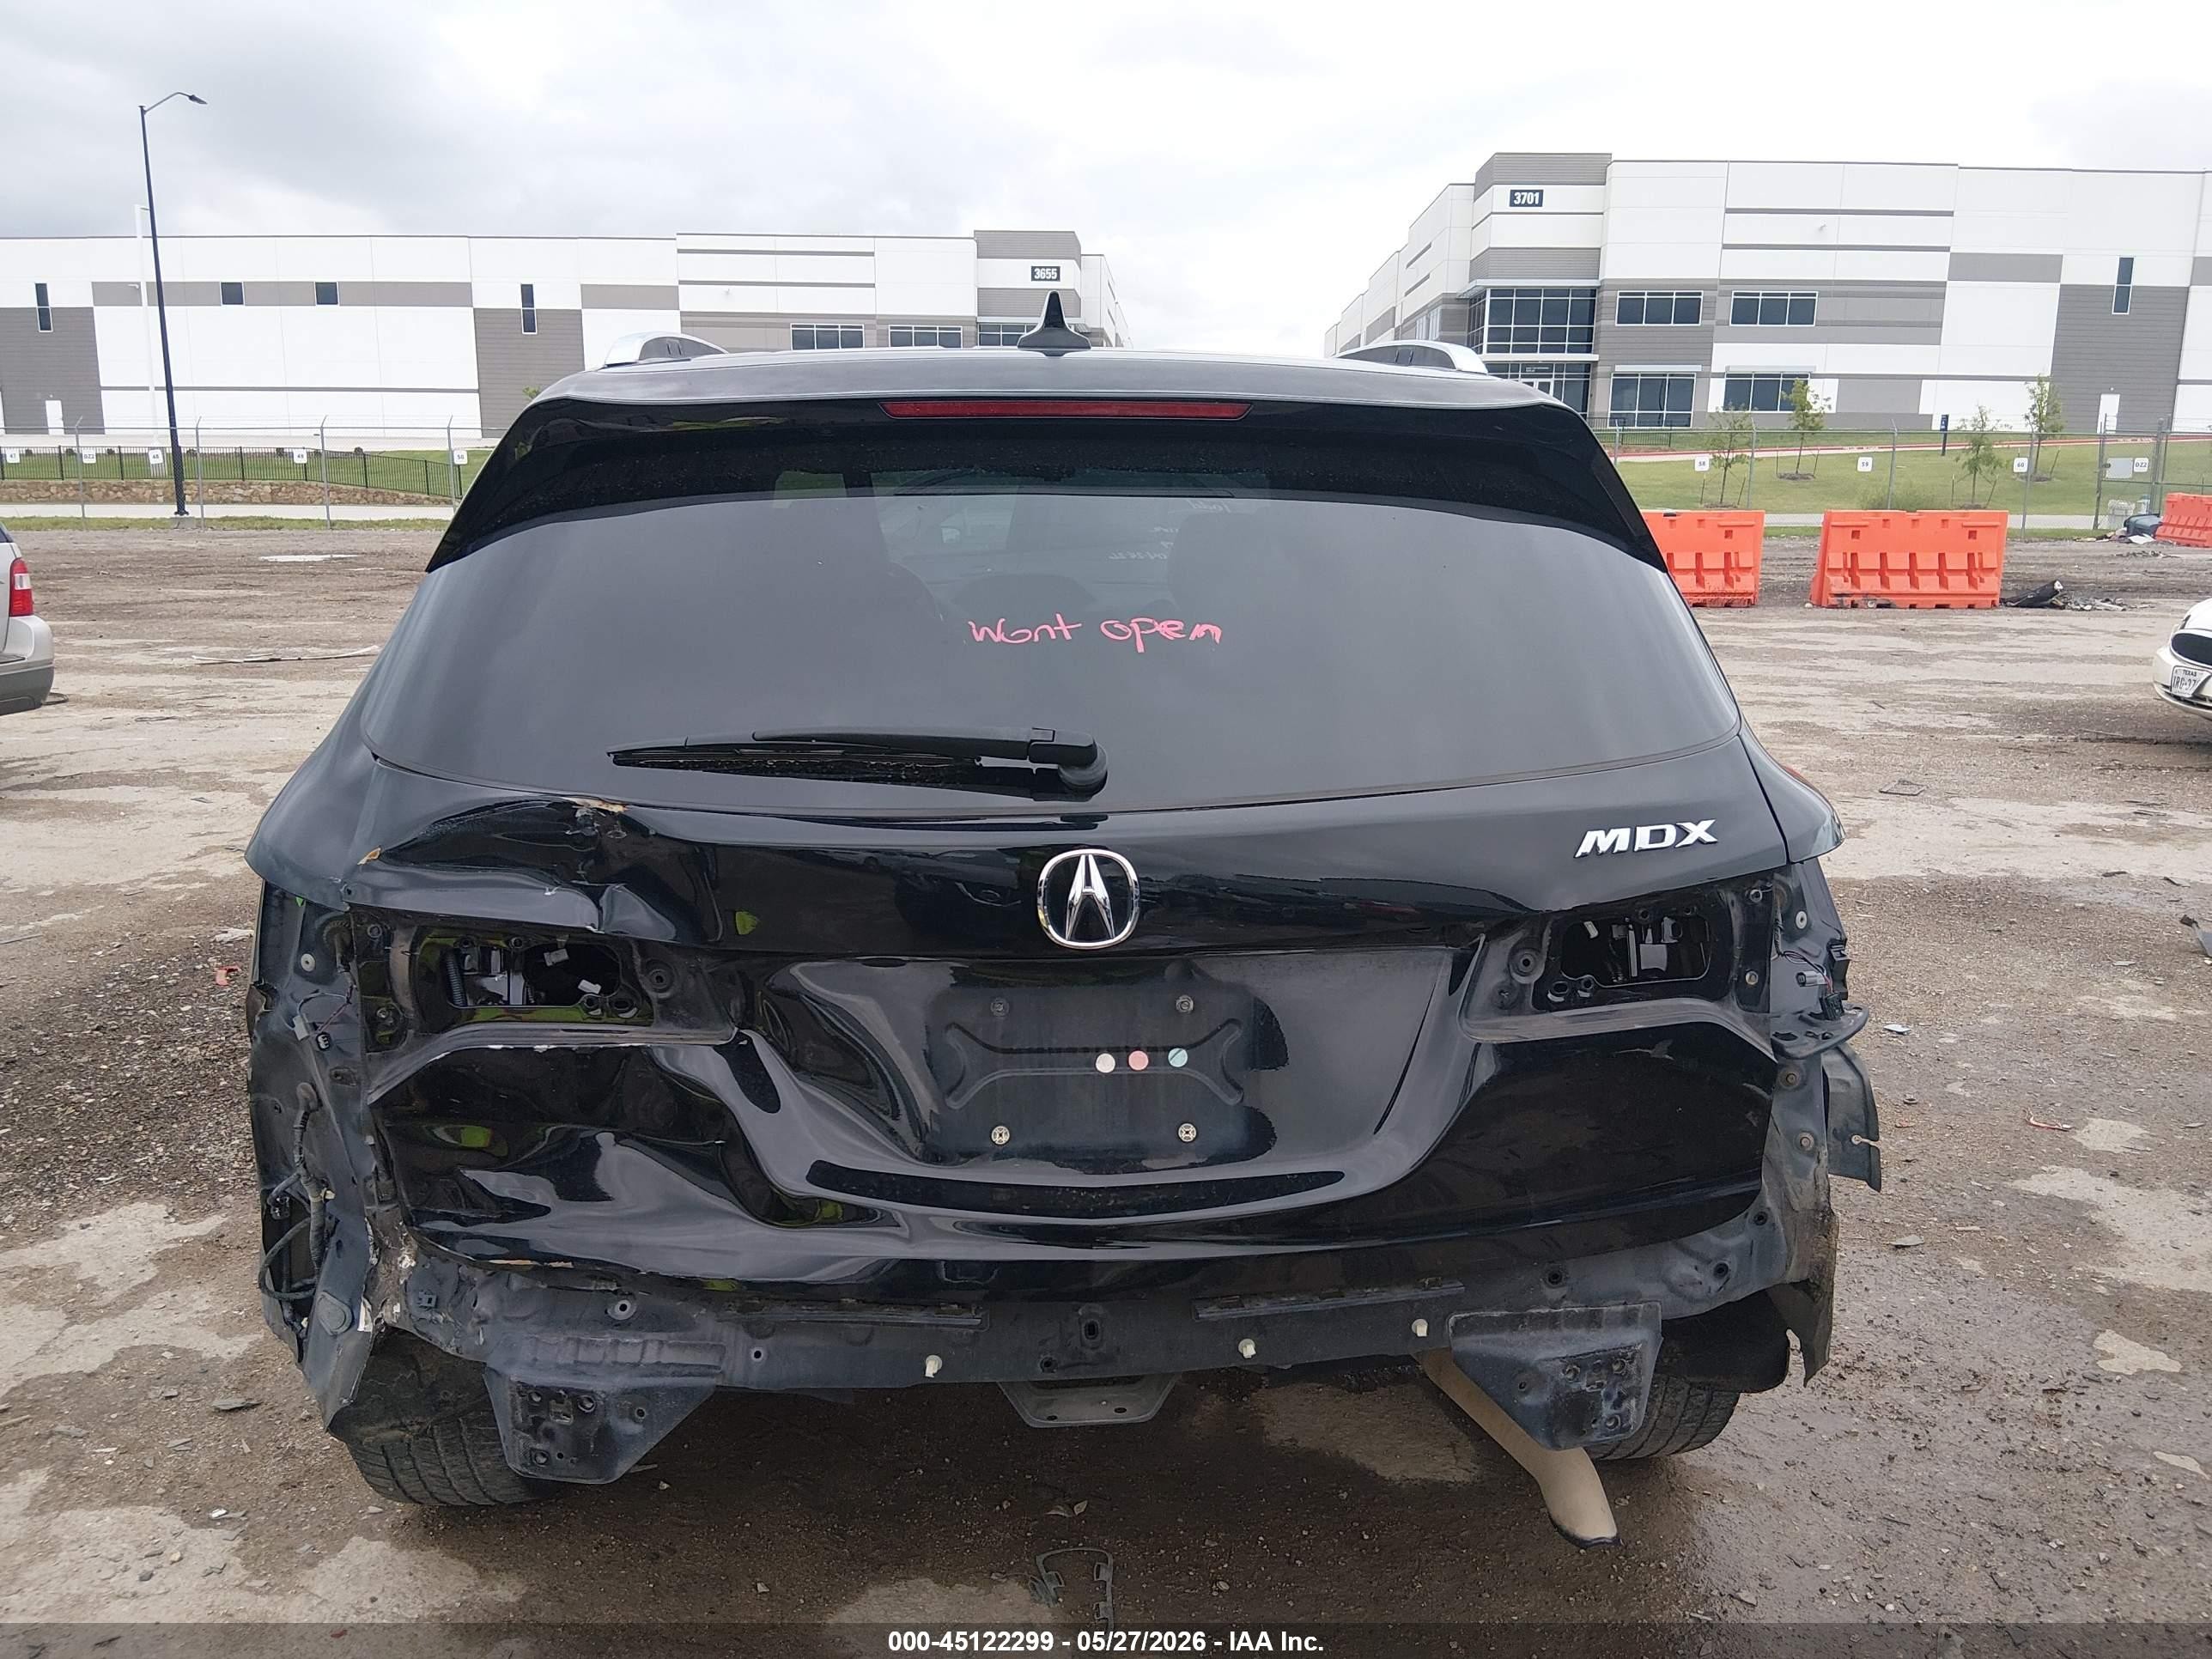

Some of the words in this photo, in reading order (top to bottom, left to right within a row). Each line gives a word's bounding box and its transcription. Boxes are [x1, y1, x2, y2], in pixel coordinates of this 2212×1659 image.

[1513, 191, 1539, 205] 3701
[1034, 268, 1057, 280] 3655
[1100, 617, 1223, 653] open
[1574, 819, 1718, 859] MDX
